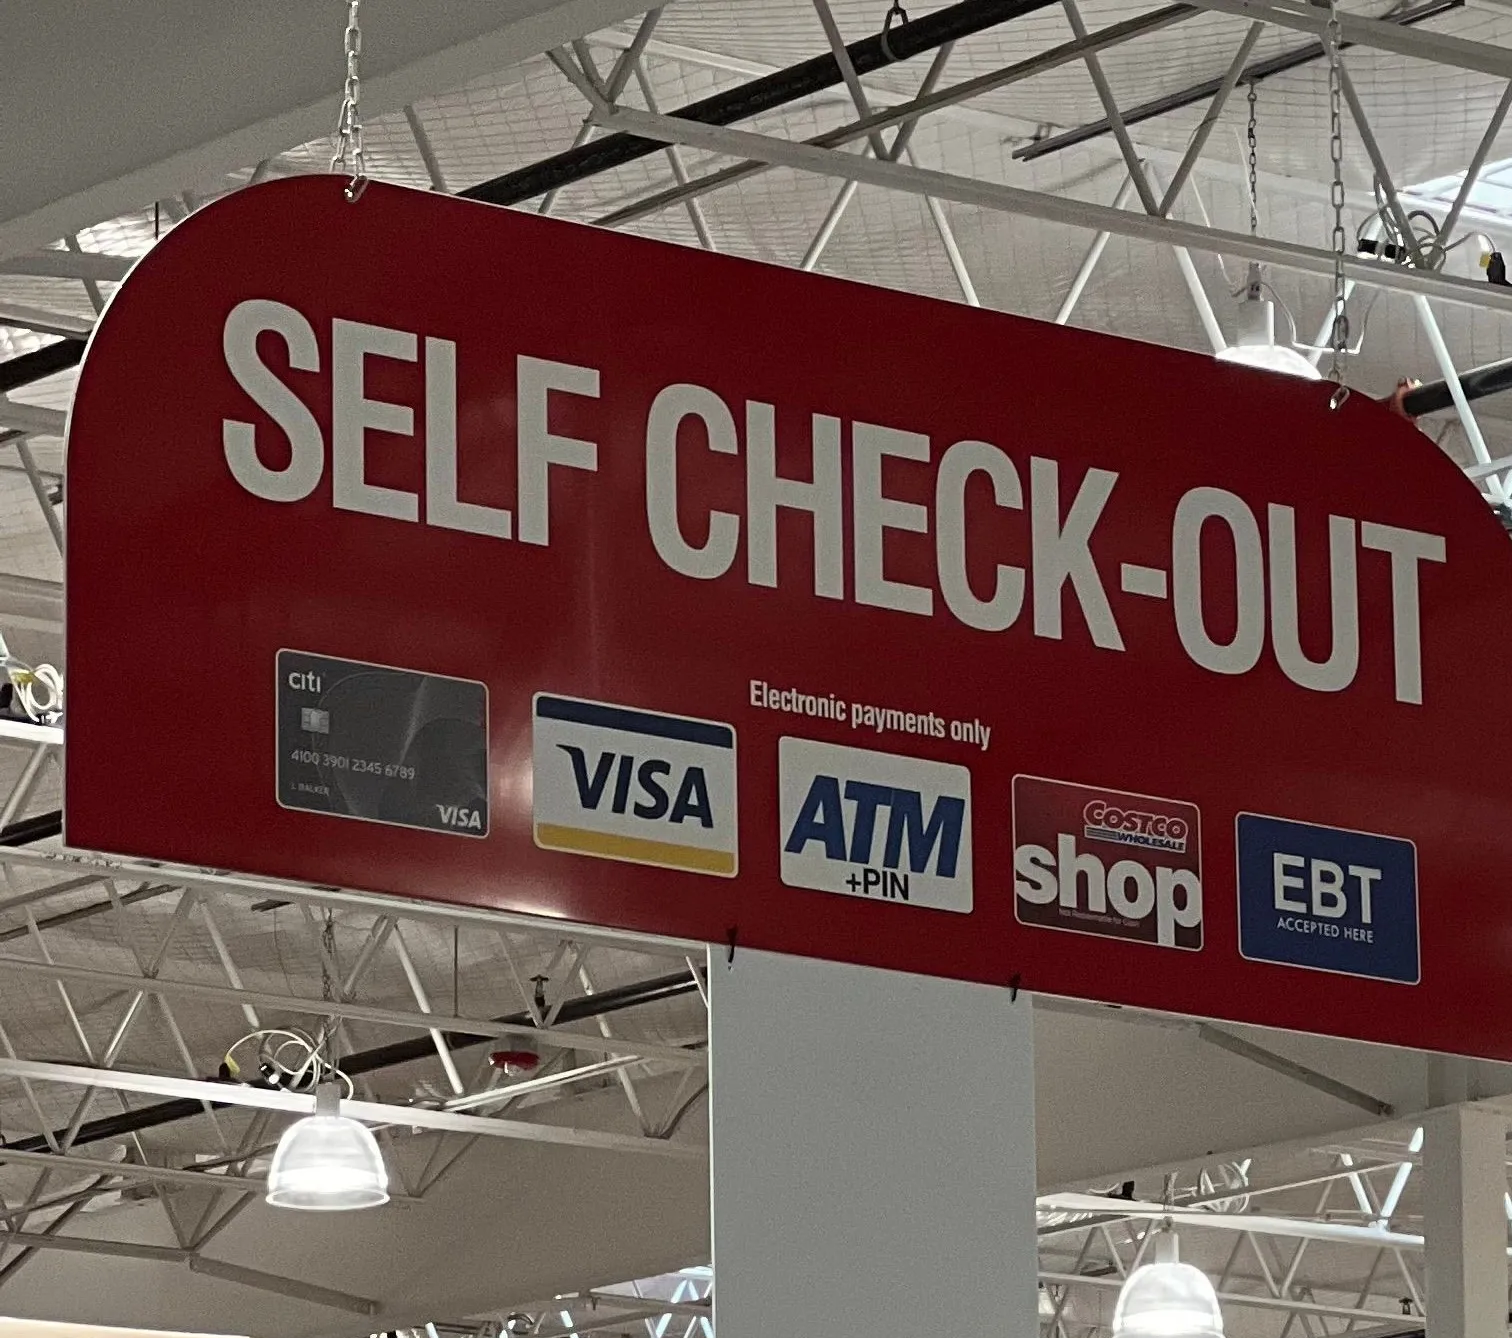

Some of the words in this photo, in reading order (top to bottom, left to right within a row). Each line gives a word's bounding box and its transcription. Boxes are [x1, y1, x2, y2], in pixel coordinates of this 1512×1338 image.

[223, 299, 601, 546] SELF
[645, 383, 1447, 706] CHECK-OUT
[288, 671, 322, 693] citi
[750, 680, 846, 721] Electronic
[851, 702, 945, 734] payments
[950, 718, 991, 751] only
[291, 750, 320, 765] 4100
[322, 755, 350, 770] 3901
[352, 759, 382, 775] 2345
[385, 766, 416, 780] 6789
[556, 744, 714, 829] VISA
[436, 804, 481, 830] VISA
[784, 775, 965, 878] ATM
[1083, 800, 1188, 842] COSTCO
[1118, 832, 1185, 850] WHOLESALE
[846, 868, 909, 901] +PIN
[1015, 833, 1202, 947] shop
[1274, 853, 1382, 924] EBT
[1277, 917, 1340, 938] ACCEPTED
[1344, 926, 1374, 943] HERE
